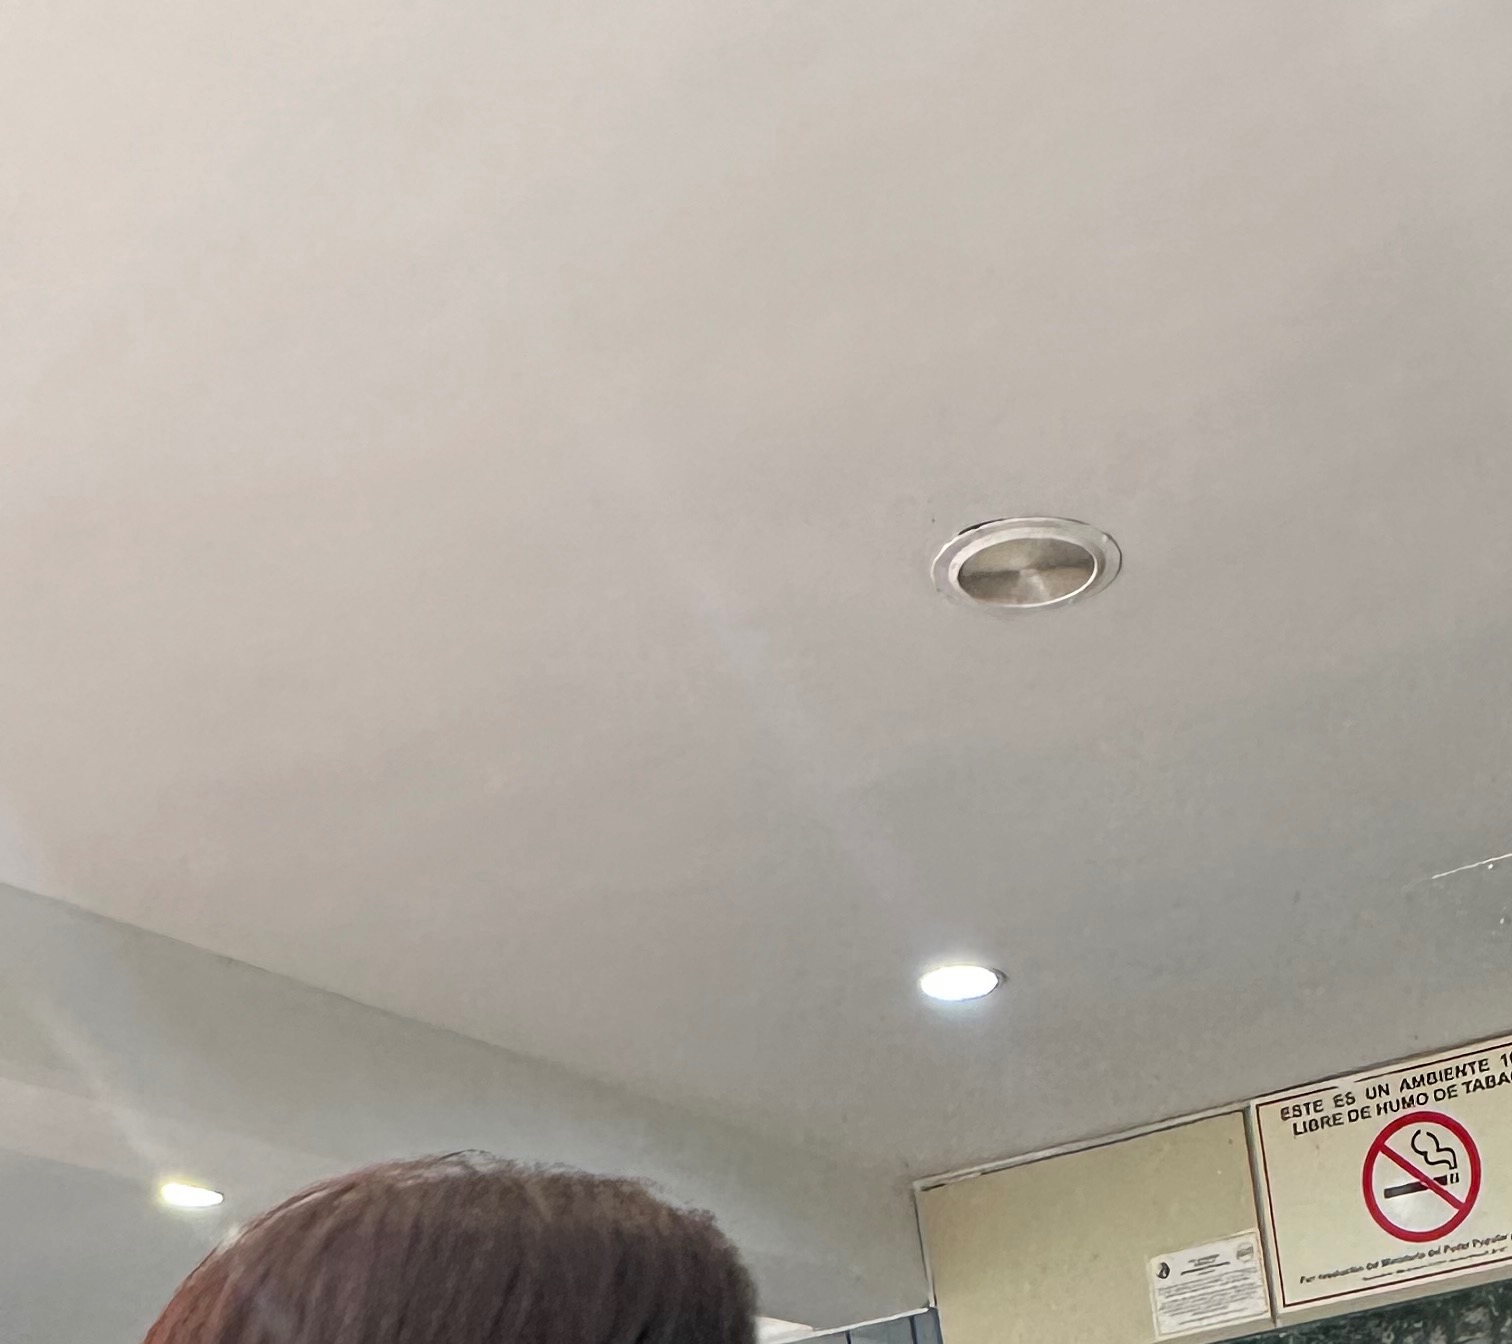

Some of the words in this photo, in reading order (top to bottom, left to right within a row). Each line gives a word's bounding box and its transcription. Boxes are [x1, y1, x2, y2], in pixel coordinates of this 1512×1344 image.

[1280, 1098, 1324, 1121] ESTE
[1333, 1092, 1356, 1108] ES
[1365, 1083, 1390, 1100] UN
[1399, 1058, 1490, 1093] AMBIENTE
[1292, 1111, 1345, 1136] LIBRE
[1347, 1105, 1372, 1123] DE
[1376, 1092, 1429, 1116] HUMO
[1433, 1085, 1459, 1102] DE
